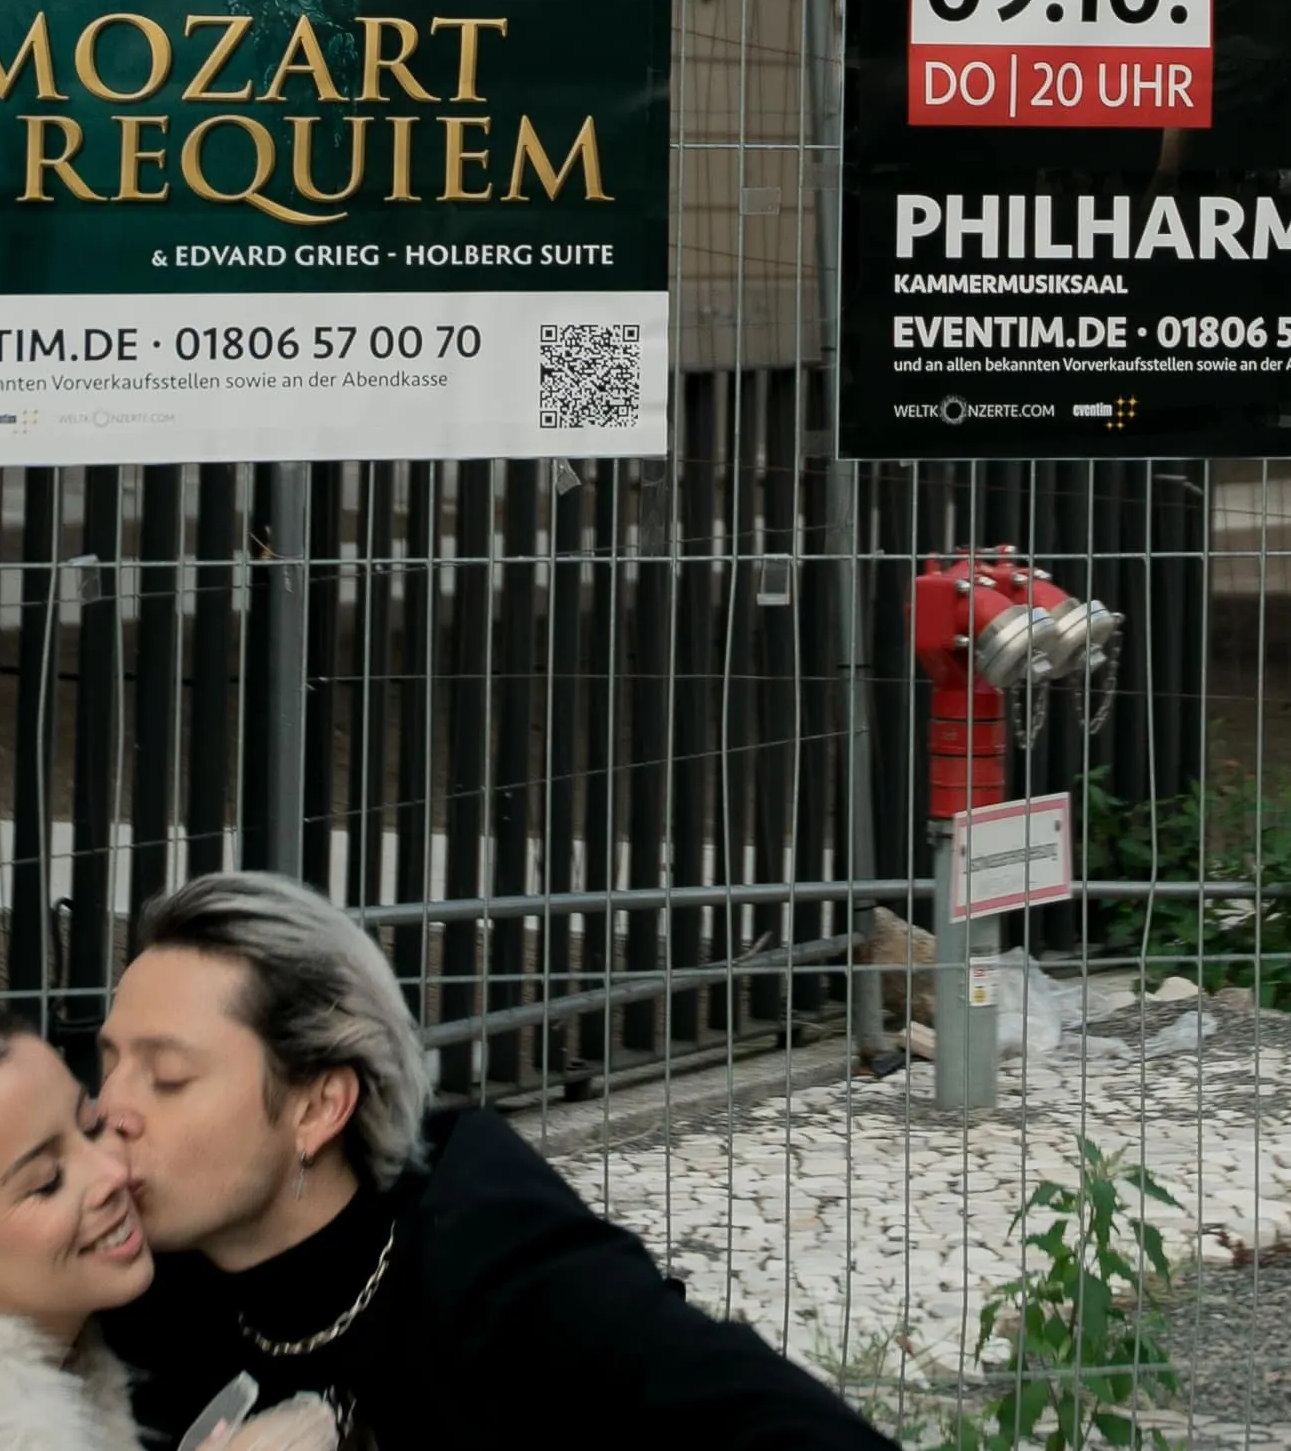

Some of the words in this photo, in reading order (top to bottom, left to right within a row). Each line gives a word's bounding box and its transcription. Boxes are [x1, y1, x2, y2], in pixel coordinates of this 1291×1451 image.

[925, 61, 995, 106] DO
[1030, 62, 1083, 107] 20
[1098, 63, 1195, 108] UHR
[17, 114, 615, 226] REQUIEM
[151, 249, 168, 267] &
[175, 245, 287, 267] EDVARD
[294, 244, 379, 266] GRIEG
[406, 244, 532, 266] HOLBERG
[540, 244, 614, 265] SUITE
[894, 274, 1129, 294] KAMMERMUSIKSAAL
[175, 326, 300, 361] 01806
[313, 326, 357, 359] 57
[370, 325, 423, 359] 00
[436, 324, 481, 358] 70
[893, 315, 1127, 348] EVENTIM.DE
[1156, 316, 1268, 348] 01806
[893, 356, 922, 372] und
[925, 360, 943, 372] an
[946, 356, 982, 372] allen
[985, 356, 1061, 372] bekannten
[1062, 356, 1194, 372] Vorverkaufsstellen
[1196, 357, 1238, 372] sowie
[1239, 360, 1258, 371] an
[1260, 356, 1284, 372] der
[51, 372, 220, 391] Vorverkaufsstellen
[225, 376, 277, 389] sowie
[281, 375, 303, 388] an
[308, 371, 337, 388] der
[341, 370, 448, 388] Abendkasse
[1072, 402, 1113, 417] eventim
